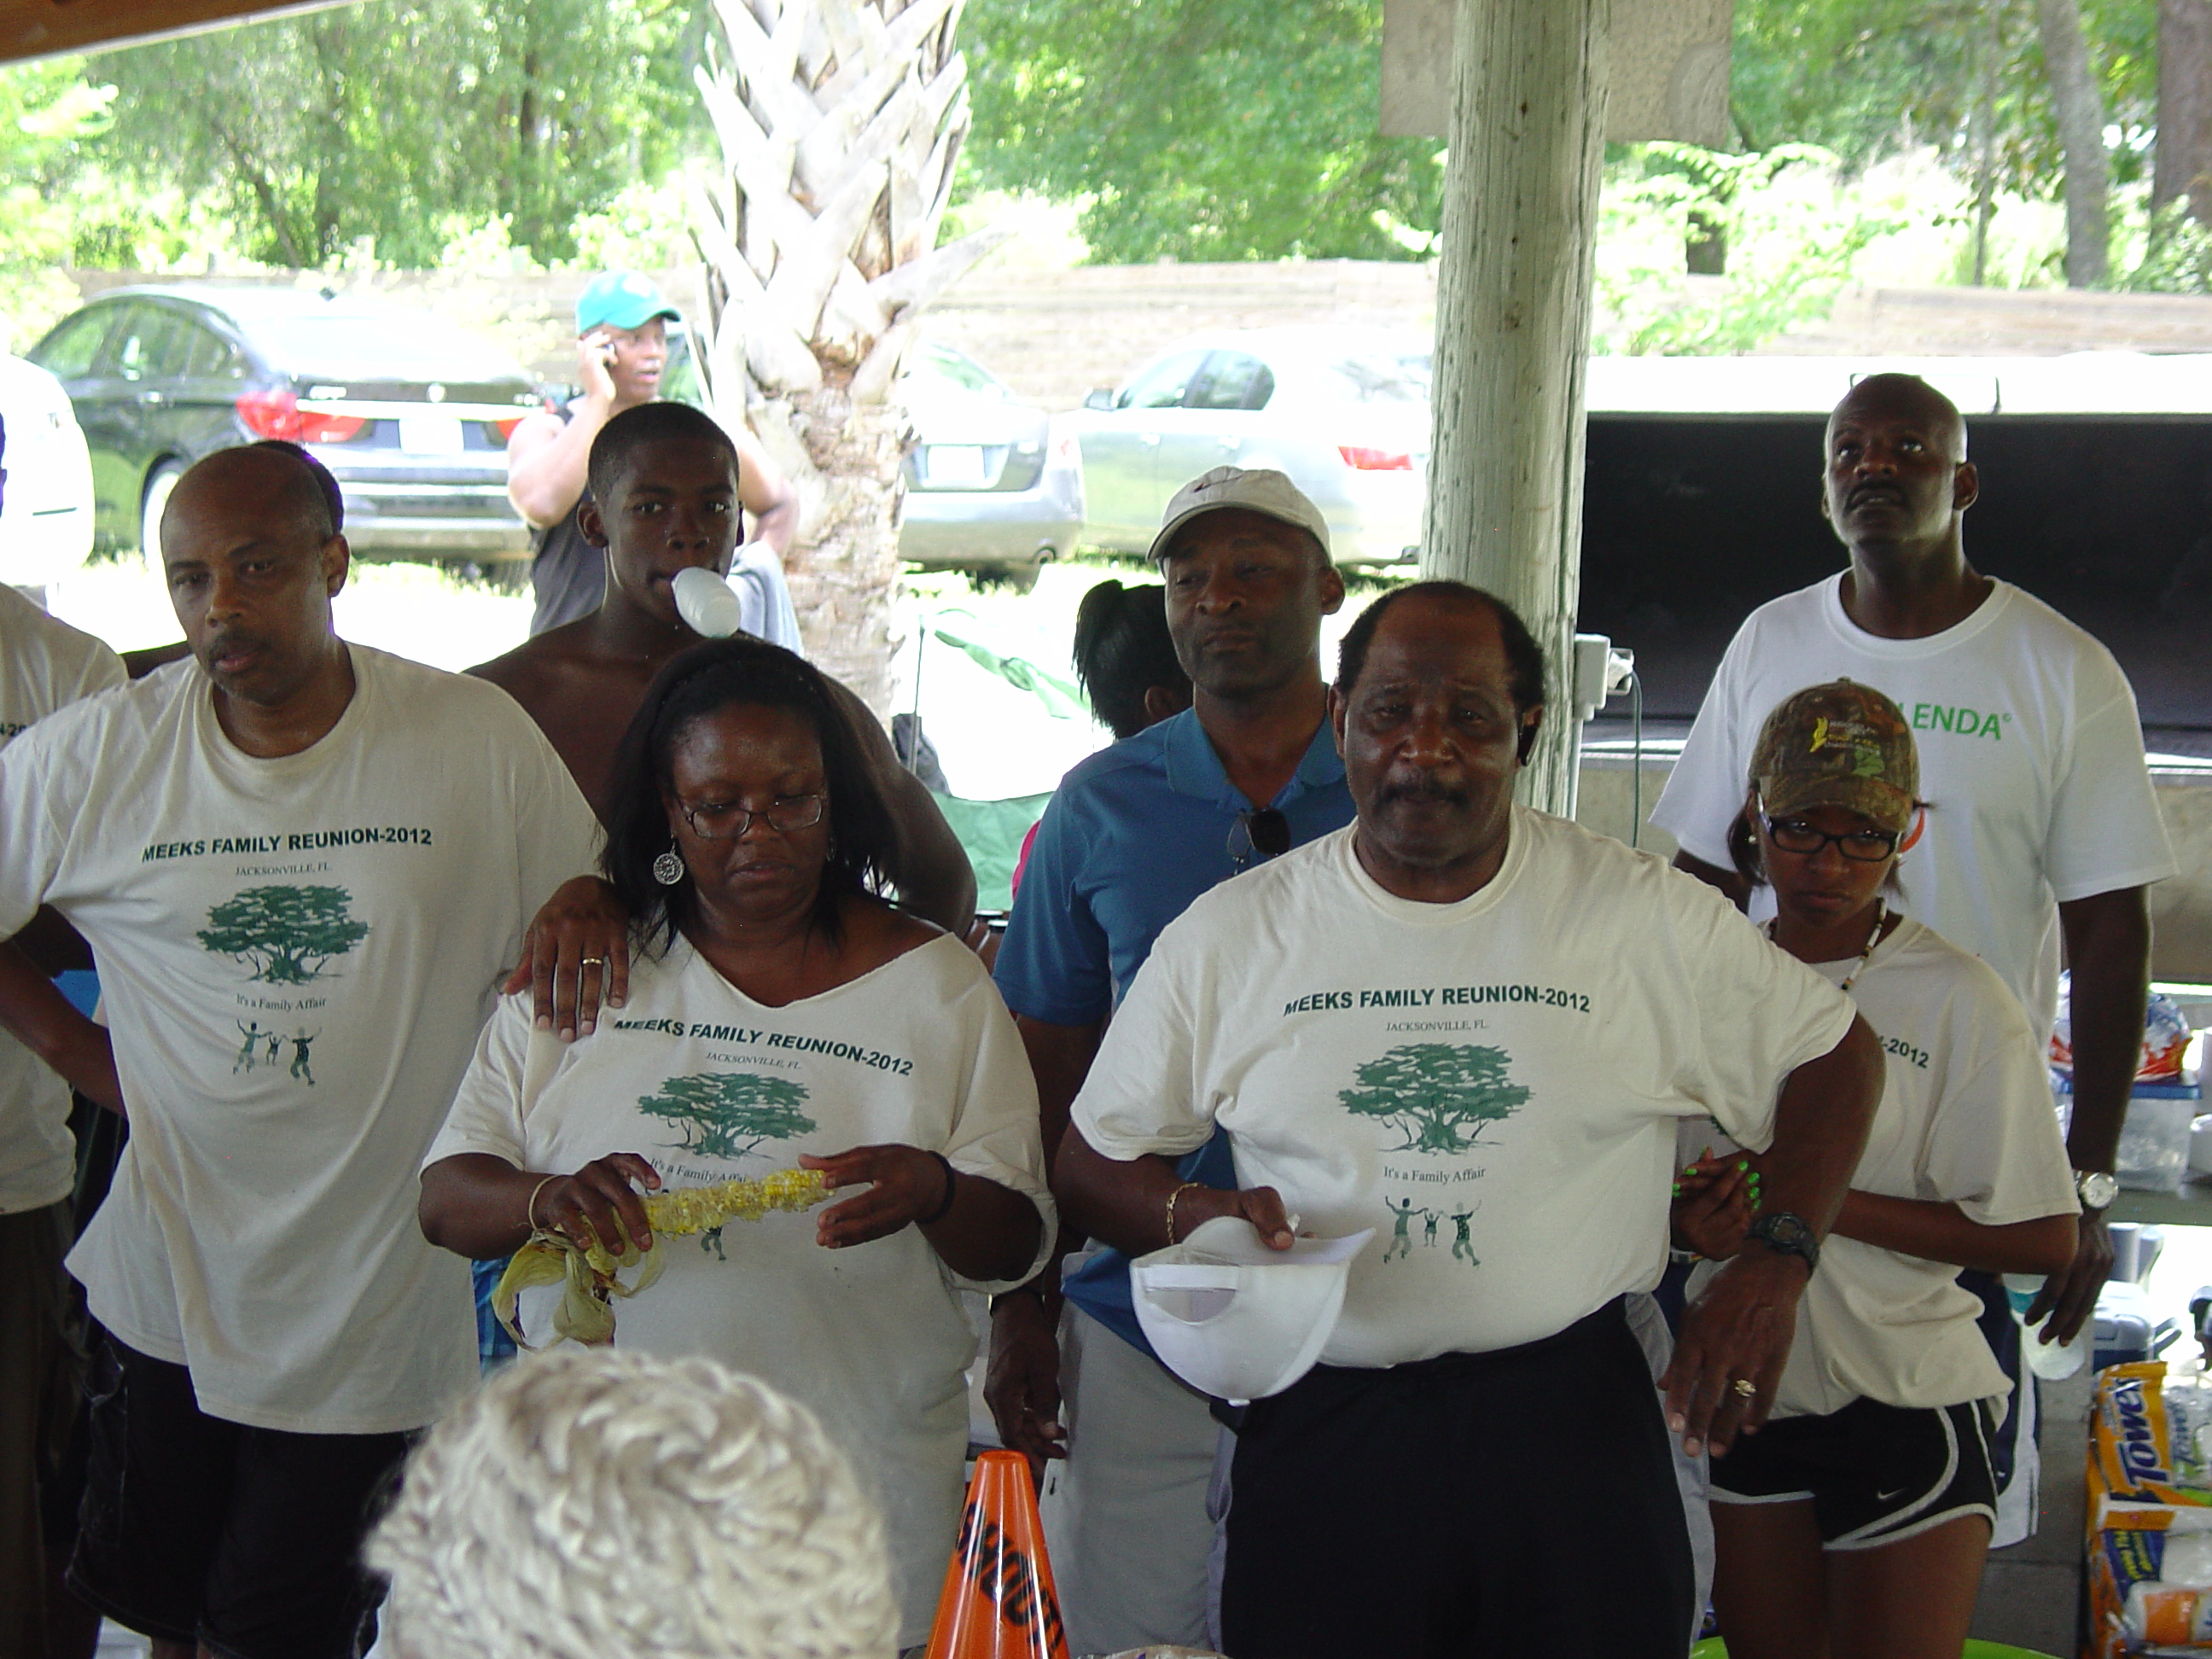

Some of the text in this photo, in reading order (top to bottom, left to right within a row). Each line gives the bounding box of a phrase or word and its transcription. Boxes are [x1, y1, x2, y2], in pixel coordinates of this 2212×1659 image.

[142, 828, 432, 863] MEEKS FAMILY REUNION-2012
[236, 993, 248, 1006] It's
[259, 998, 292, 1012] Family
[295, 997, 326, 1010] Affair
[1284, 985, 1591, 1017] MEEKS FAMILY REUNION-2012
[614, 1018, 914, 1076] MEEKS FAMILY REUNION-2012
[650, 1158, 665, 1171] It's
[667, 1164, 674, 1173] a
[677, 1164, 716, 1184] Family
[1383, 1166, 1486, 1185] It's a Family Affair
